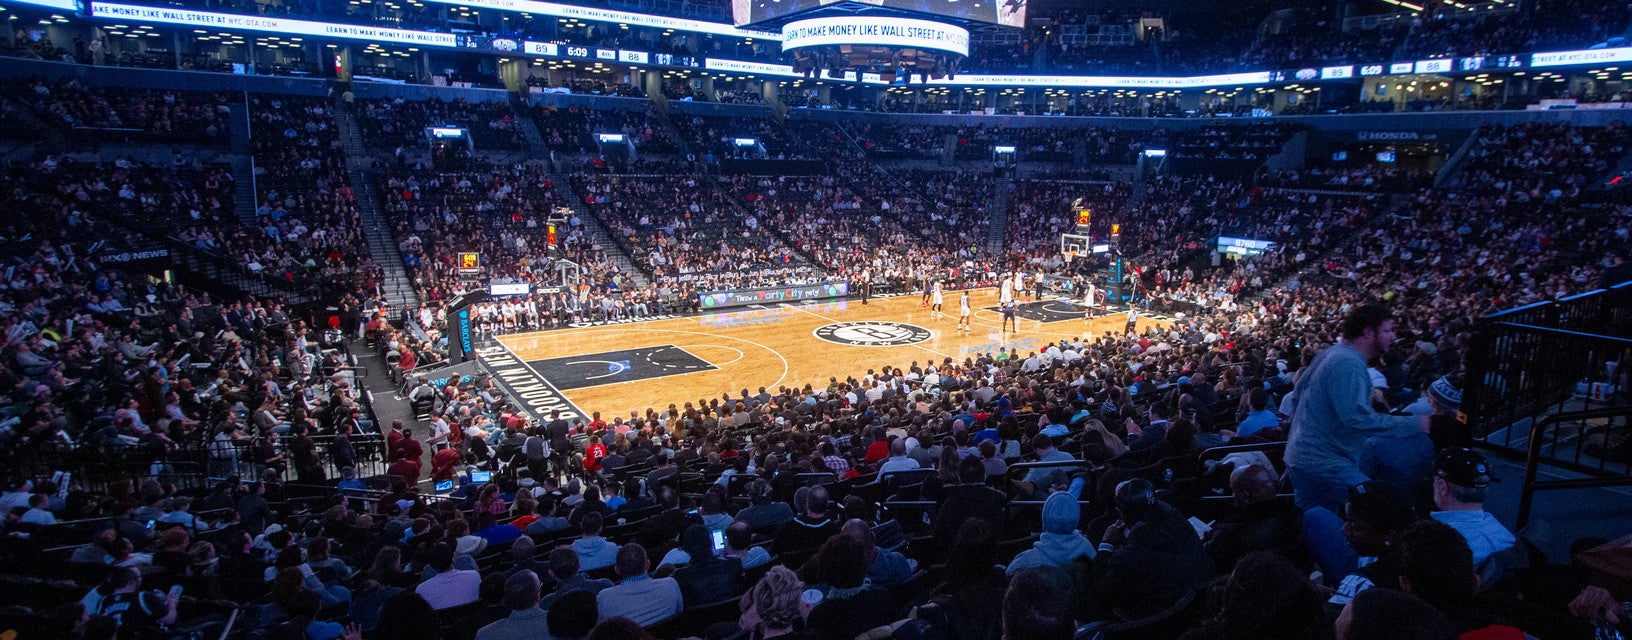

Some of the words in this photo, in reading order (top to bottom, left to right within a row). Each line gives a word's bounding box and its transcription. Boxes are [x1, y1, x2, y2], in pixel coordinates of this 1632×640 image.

[112, 8, 139, 16] MONEY
[142, 10, 160, 18] LIKE
[163, 12, 184, 20] WALL
[187, 14, 214, 23] STREET
[326, 26, 348, 35] LEARN
[360, 29, 376, 37] MAKE
[379, 30, 400, 39] MONEY
[800, 28, 806, 38] TO
[807, 26, 826, 37] MAKE
[828, 25, 856, 36] MONEY
[860, 25, 878, 35] LIKE
[881, 25, 905, 37] WALL
[908, 27, 935, 40] STREET
[936, 31, 944, 41] AT
[535, 44, 548, 53] 89
[568, 46, 588, 57] 6:09
[628, 53, 639, 61] 88
[1360, 65, 1382, 75] 6:09
[1427, 62, 1440, 71] 88
[133, 249, 168, 260] NEWS
[759, 290, 785, 300] Party
[785, 288, 803, 299] City
[460, 319, 471, 353] BARCLAYS
[496, 368, 579, 422] BROOKLYN
[594, 450, 603, 458] 23
